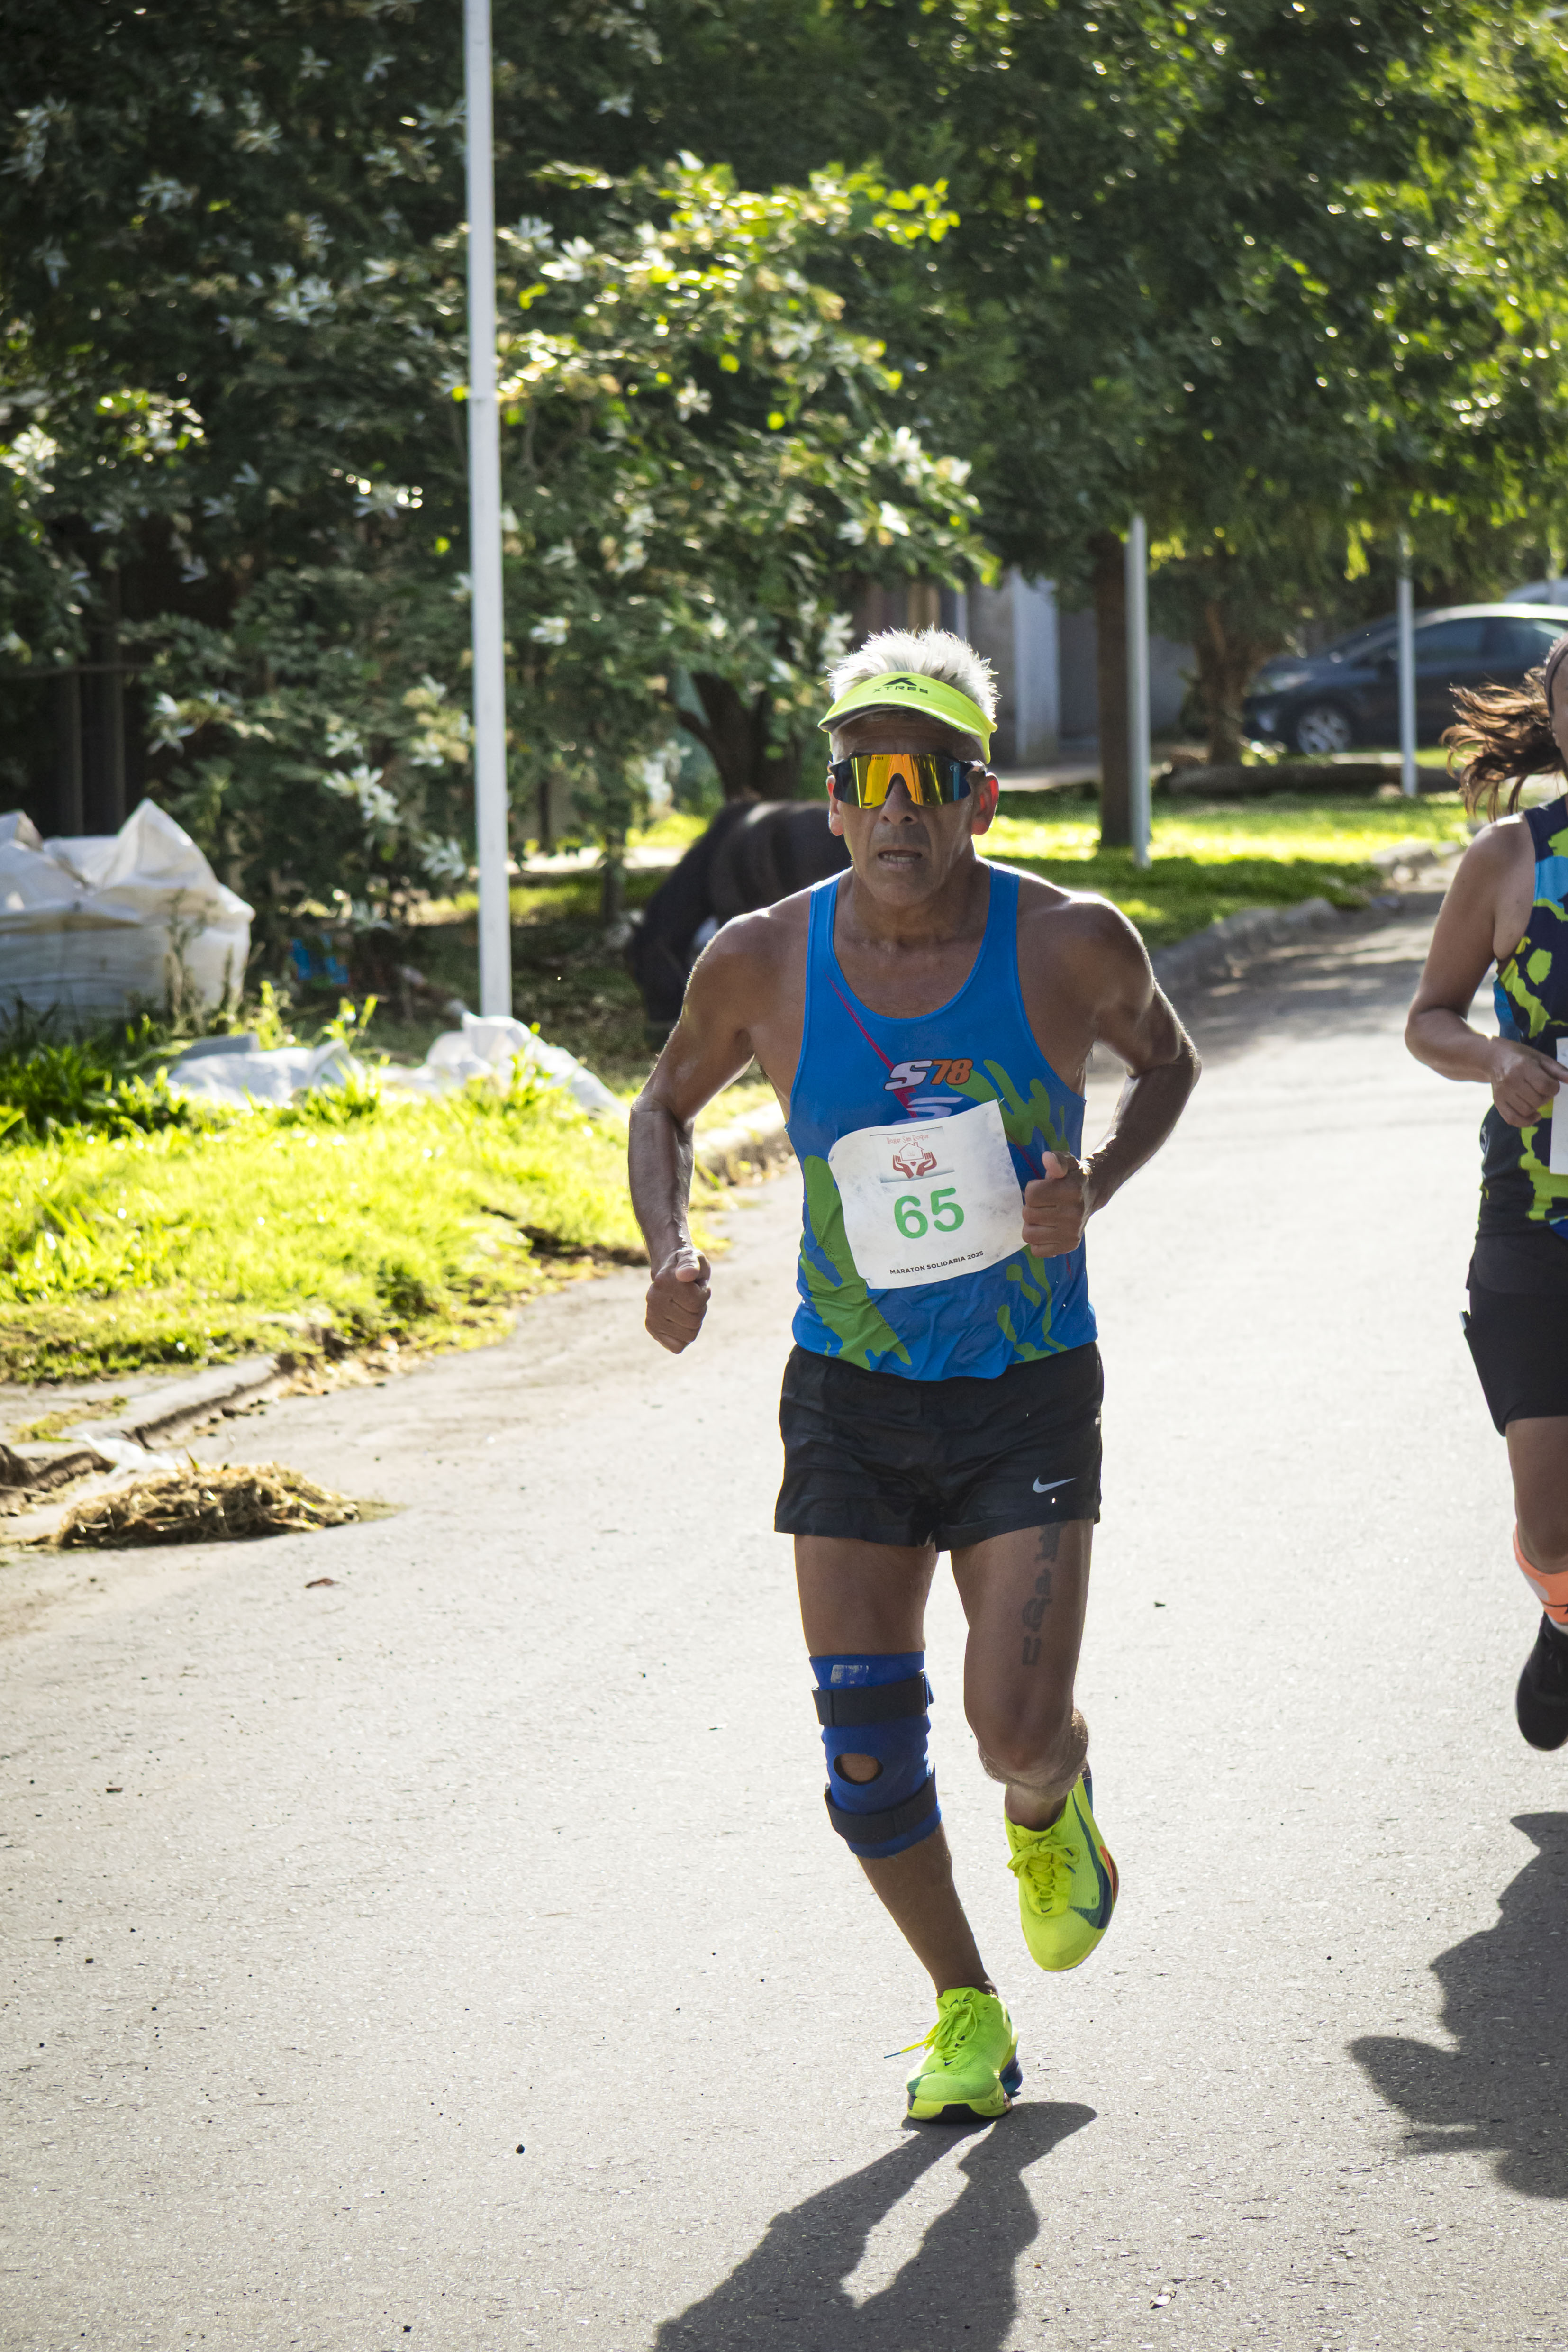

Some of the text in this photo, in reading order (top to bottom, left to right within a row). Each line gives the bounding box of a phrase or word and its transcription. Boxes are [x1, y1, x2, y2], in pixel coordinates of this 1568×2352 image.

[872, 686, 928, 694] XTRES
[894, 1187, 965, 1239] 65
[890, 1250, 984, 1275] MARATON SOLIDARIA 2025
